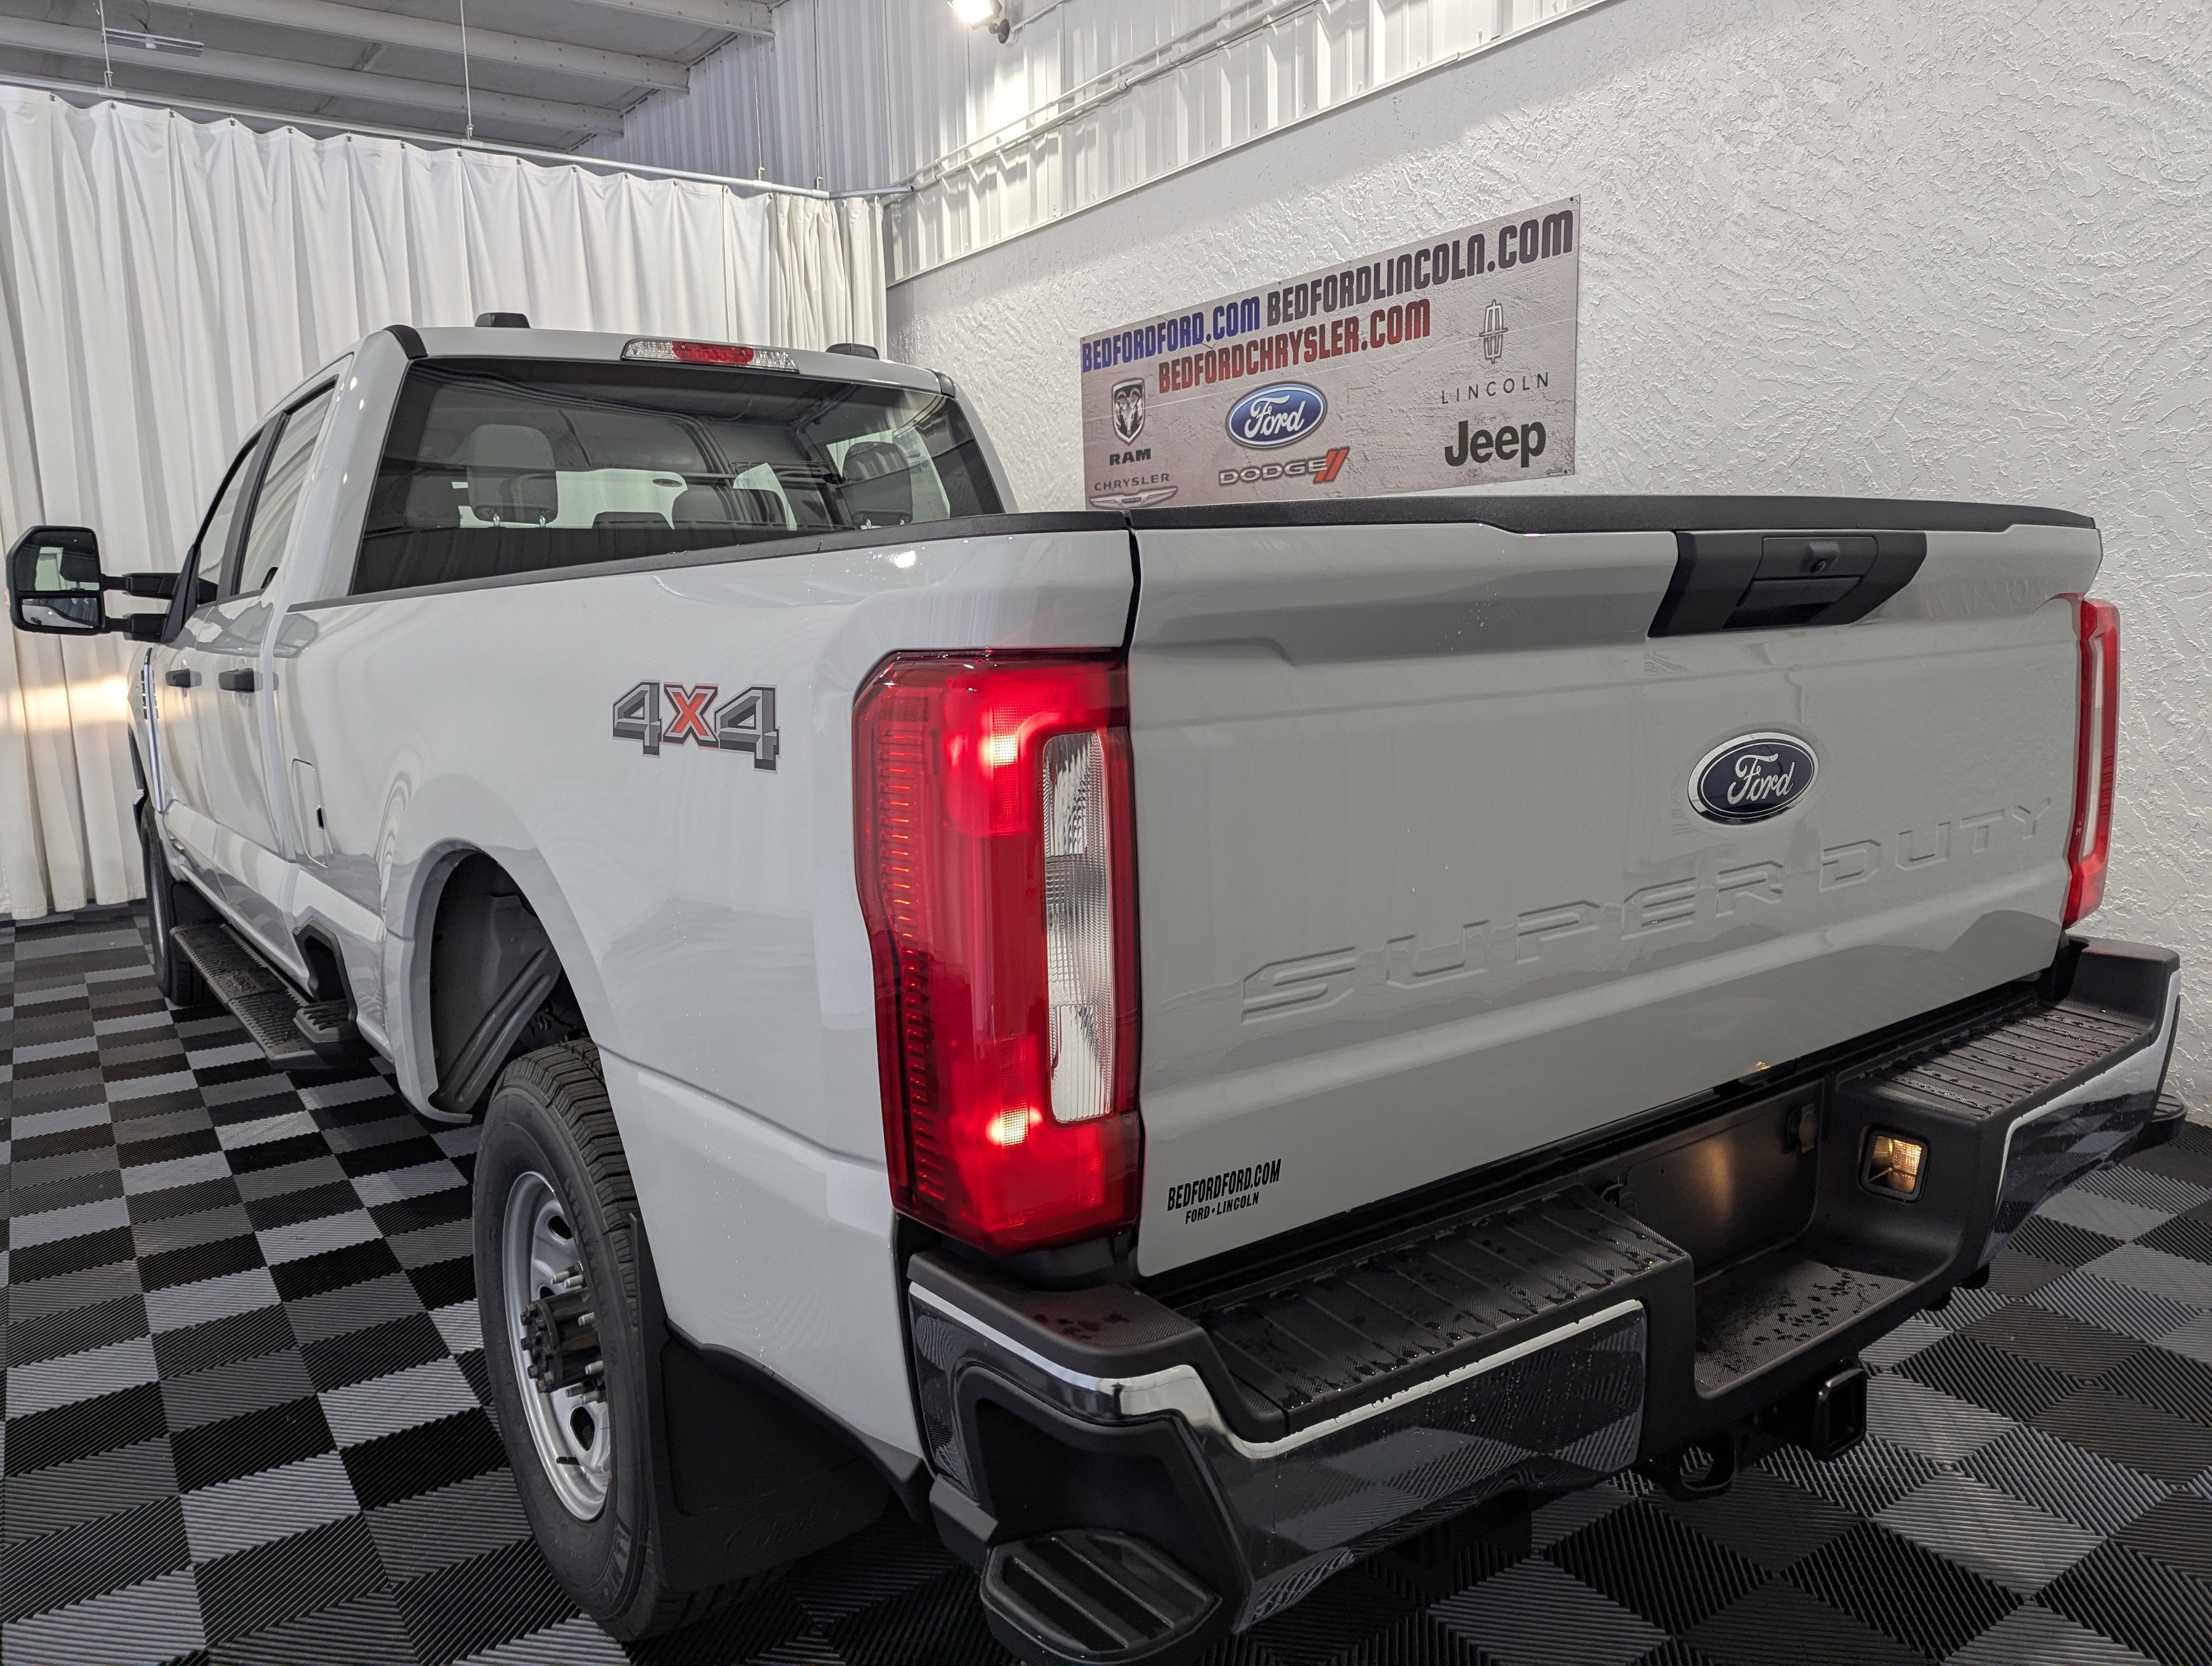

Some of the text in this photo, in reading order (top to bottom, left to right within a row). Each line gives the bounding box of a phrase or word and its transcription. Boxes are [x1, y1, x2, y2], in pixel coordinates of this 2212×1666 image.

[1083, 210, 1573, 373] BEDFORDFORD.COM BEDFORDLINCOLN.COM
[1159, 298, 1431, 394] BEDFORDCHRYSLER.COM
[1442, 372, 1548, 405] LINCOLN
[1244, 395, 1306, 438] Ford
[1109, 448, 1152, 466] RAM
[1444, 420, 1546, 469] Jeep
[1094, 473, 1170, 491] CHRYSLER
[1219, 456, 1328, 485] DODGE
[1727, 753, 1796, 805] Ford
[1240, 797, 2052, 1024] SUPER DUTY
[1167, 1158, 1281, 1211] BEDFORDFORD.COM
